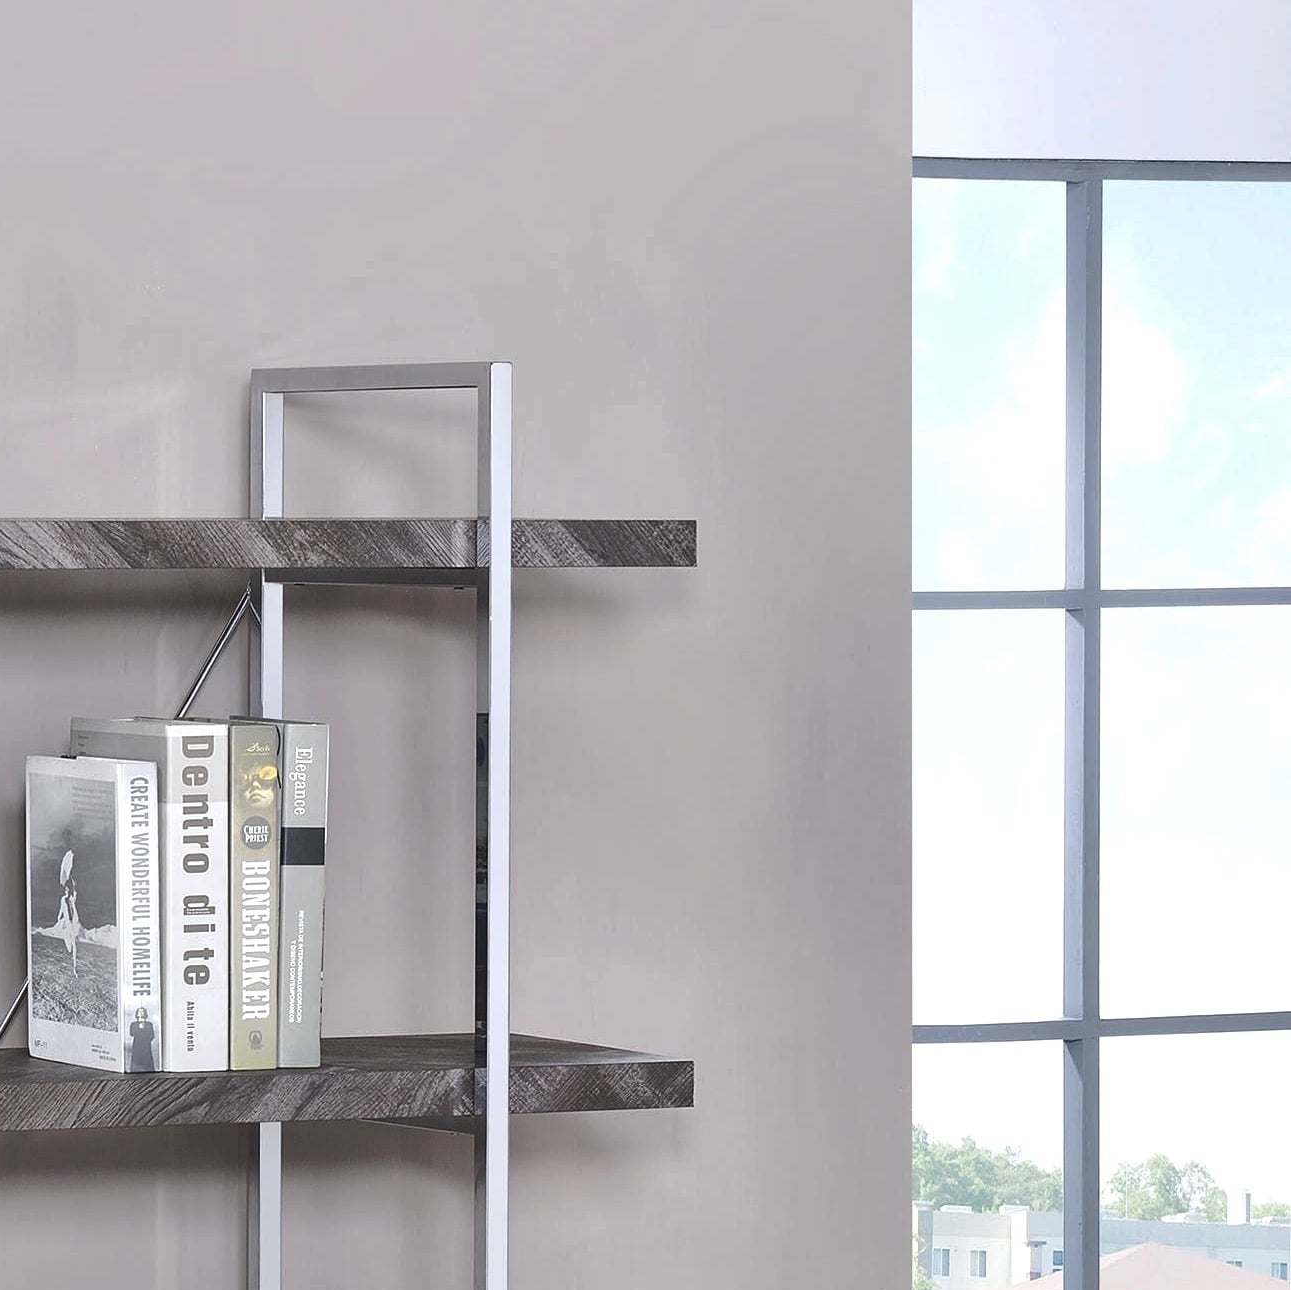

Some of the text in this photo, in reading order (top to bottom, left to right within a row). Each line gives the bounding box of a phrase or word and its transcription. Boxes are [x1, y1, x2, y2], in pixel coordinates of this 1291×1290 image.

[182, 735, 216, 985] Dentro di te
[289, 746, 313, 816] Elegance
[130, 777, 151, 996] CREATE WONDERFUL HOMELIFE
[241, 860, 270, 1020] BONESHAKER
